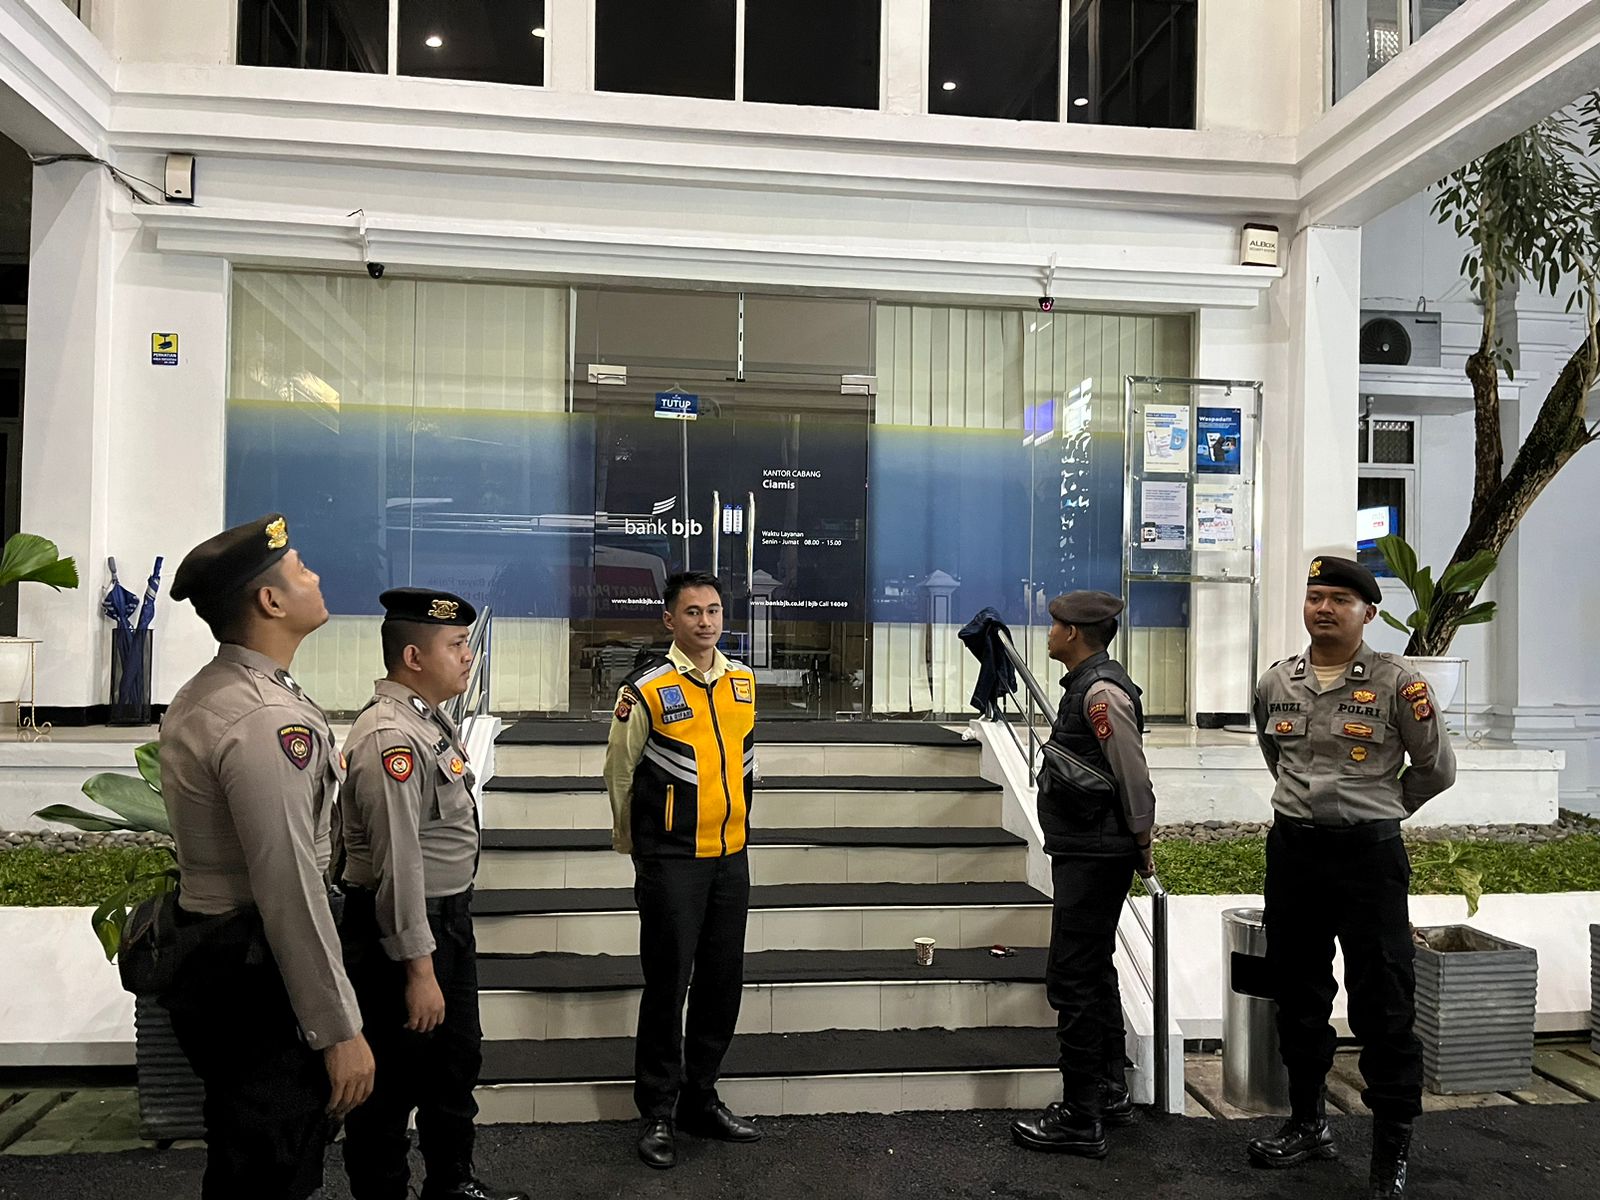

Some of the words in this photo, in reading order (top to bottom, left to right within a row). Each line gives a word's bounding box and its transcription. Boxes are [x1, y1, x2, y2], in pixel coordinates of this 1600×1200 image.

[661, 399, 692, 409] TUTUP
[763, 469, 791, 477] KANTOR
[792, 470, 821, 478] CABANG
[762, 479, 795, 489] Ciamis
[625, 518, 668, 535] bank
[671, 518, 703, 538] bjb
[780, 530, 804, 538] Layanan
[1269, 702, 1300, 713] FAUZI
[1338, 703, 1381, 718] POLRI
